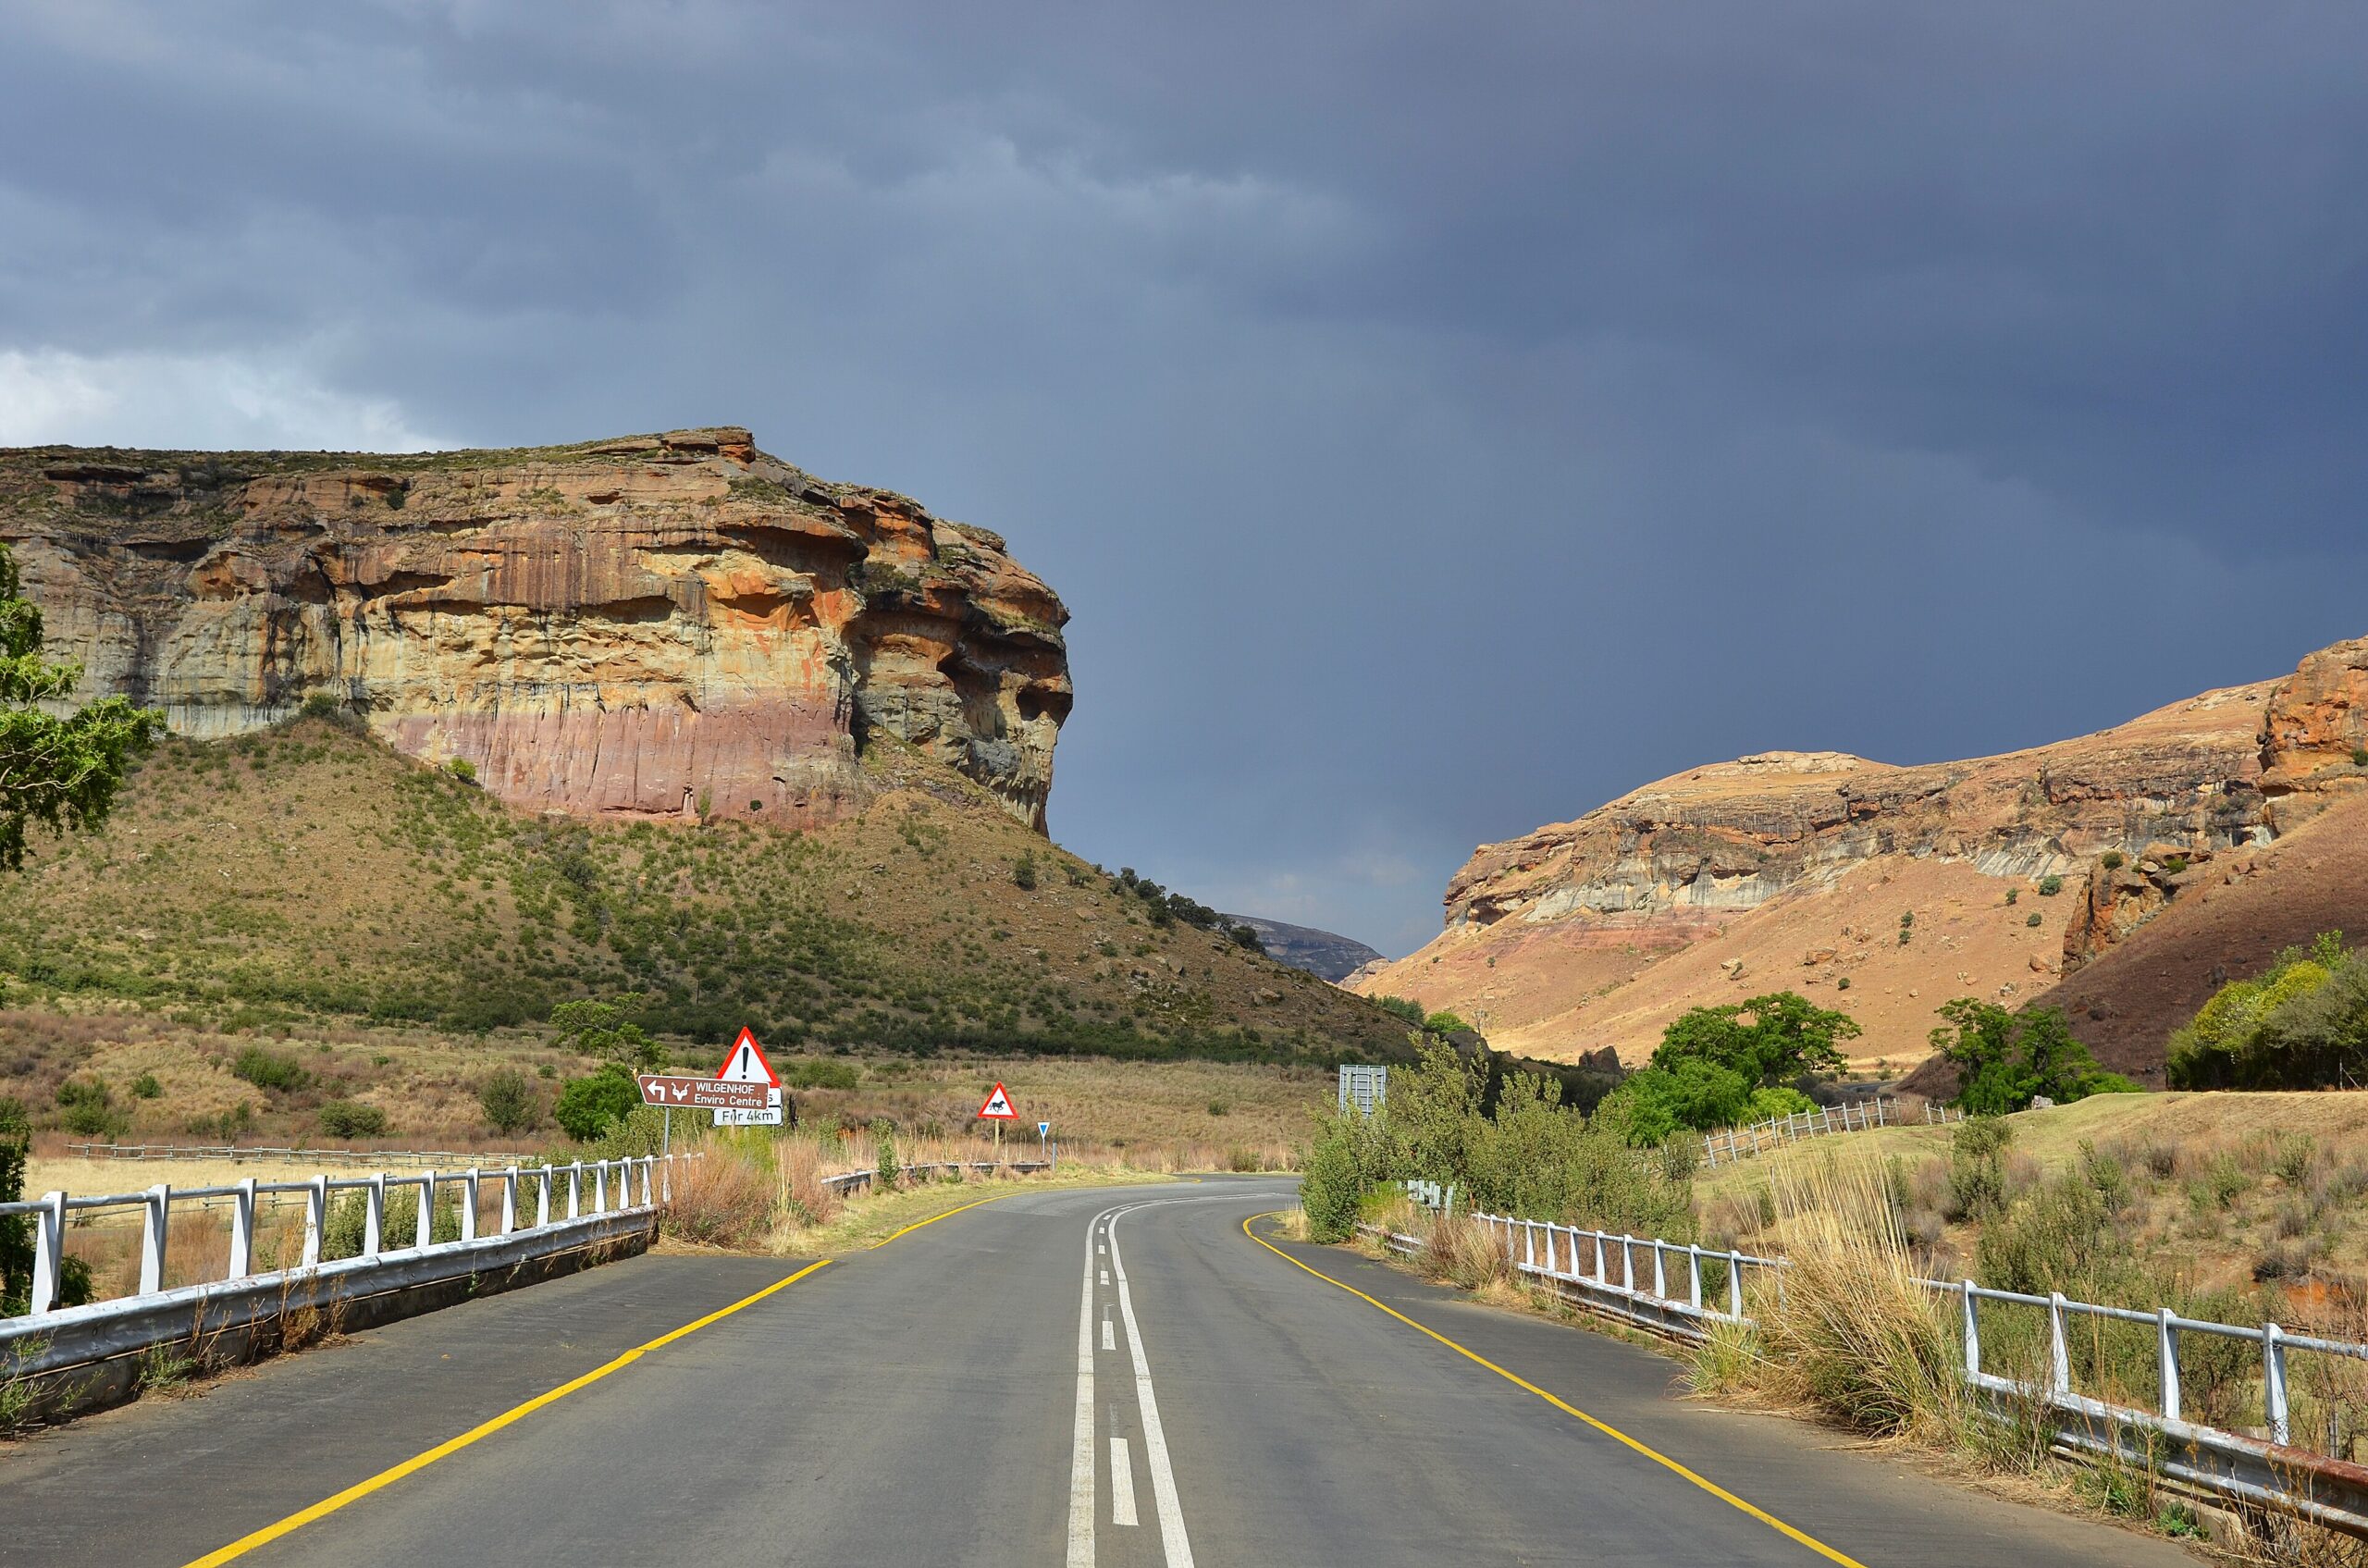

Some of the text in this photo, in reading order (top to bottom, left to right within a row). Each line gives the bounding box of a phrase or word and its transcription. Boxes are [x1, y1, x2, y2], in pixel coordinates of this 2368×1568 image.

[696, 1082, 755, 1094] WILGENHOF
[694, 1093, 725, 1105] Enviro
[729, 1096, 762, 1106] Centre
